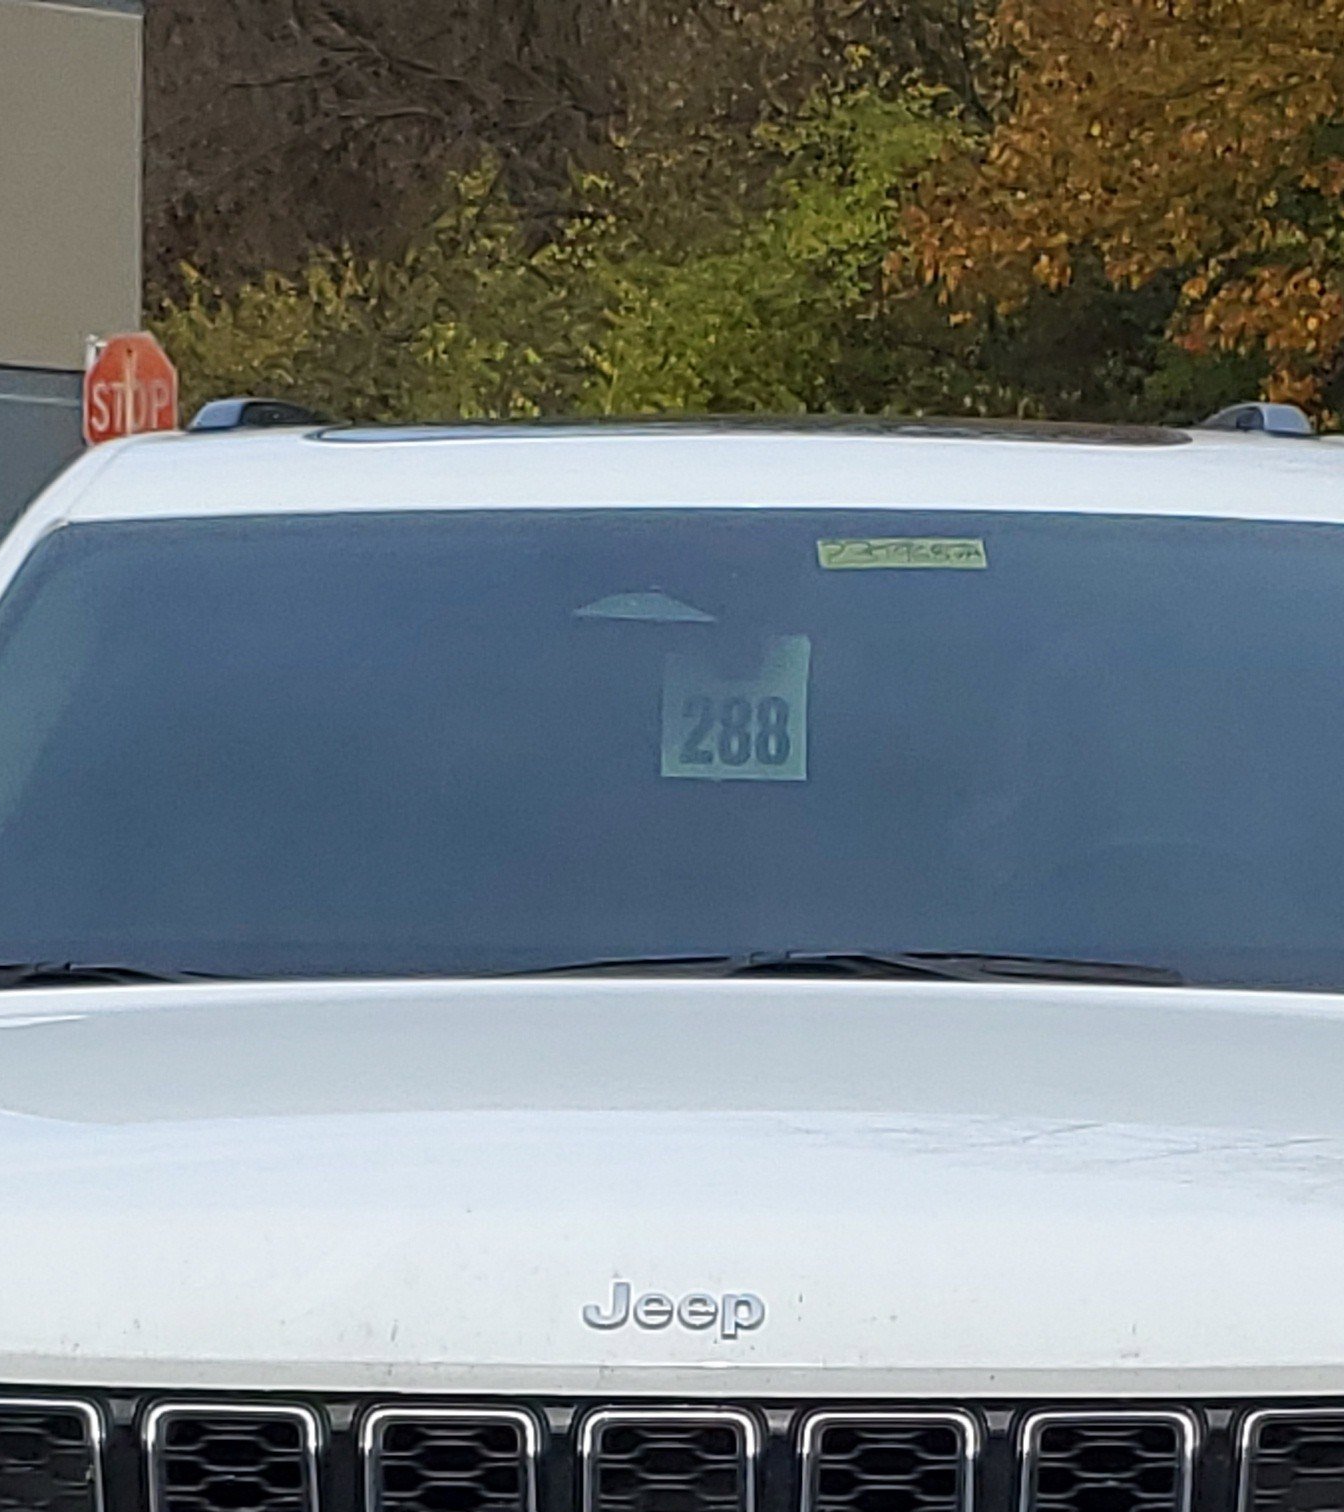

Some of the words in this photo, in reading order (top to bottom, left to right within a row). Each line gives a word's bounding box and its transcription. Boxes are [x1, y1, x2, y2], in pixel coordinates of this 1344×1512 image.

[90, 378, 170, 434] STOP
[678, 695, 791, 767] 288
[582, 1281, 766, 1340] Jeep
